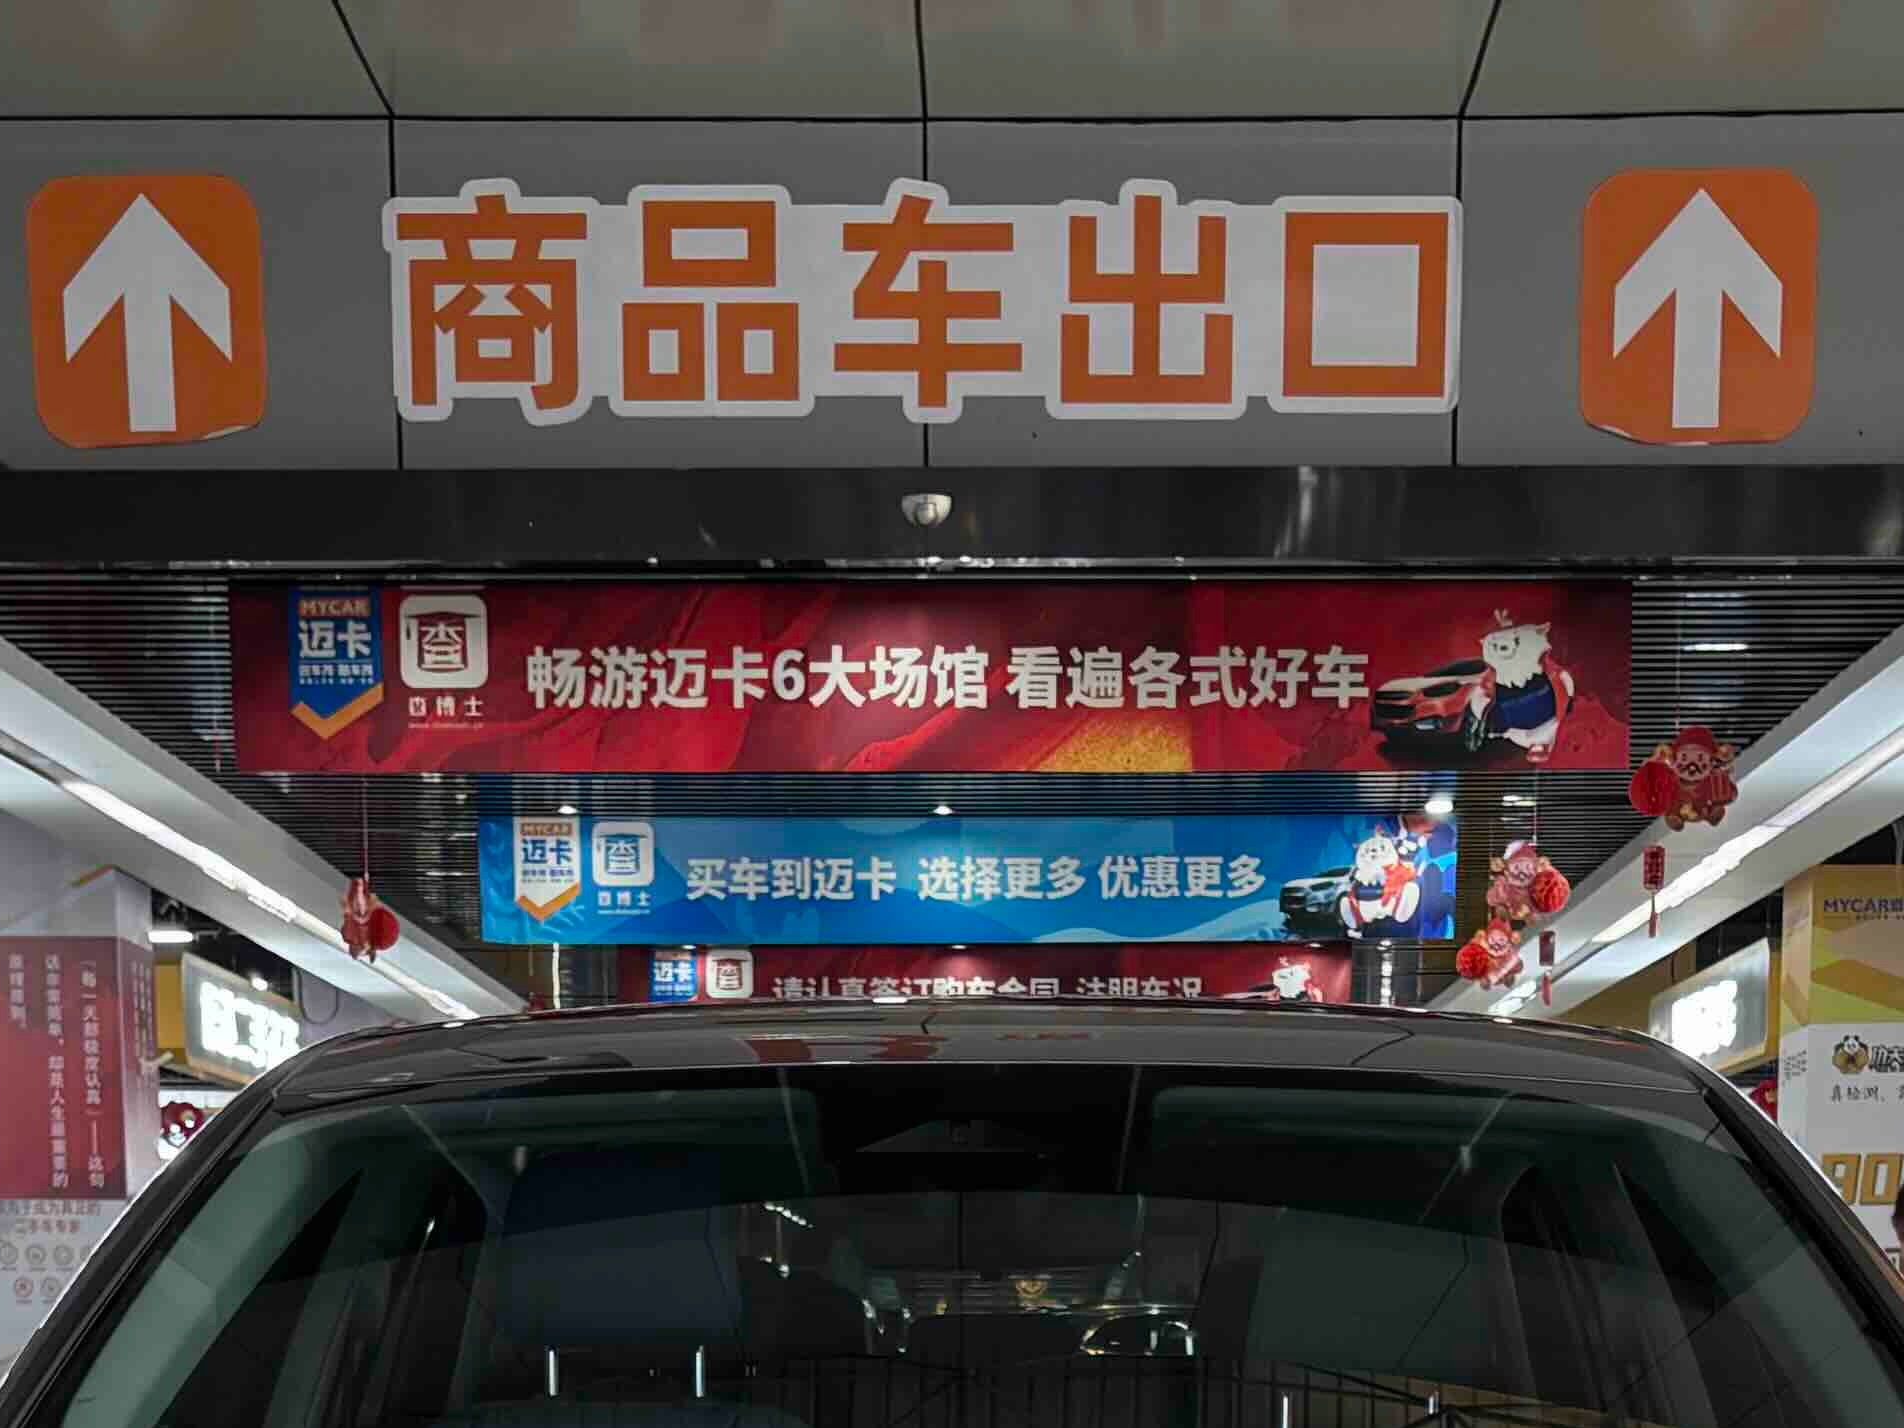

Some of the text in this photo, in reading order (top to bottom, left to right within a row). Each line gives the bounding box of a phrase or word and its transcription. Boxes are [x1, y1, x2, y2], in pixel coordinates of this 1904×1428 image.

[388, 184, 1456, 418] 商品车出口
[298, 620, 372, 659] 迈卡
[526, 644, 1370, 710] 畅游迈卡6大场馆 看遍各式好车
[522, 838, 573, 865] 迈卡
[685, 855, 1268, 903] 买车到迈卡 选择更多 优惠更多
